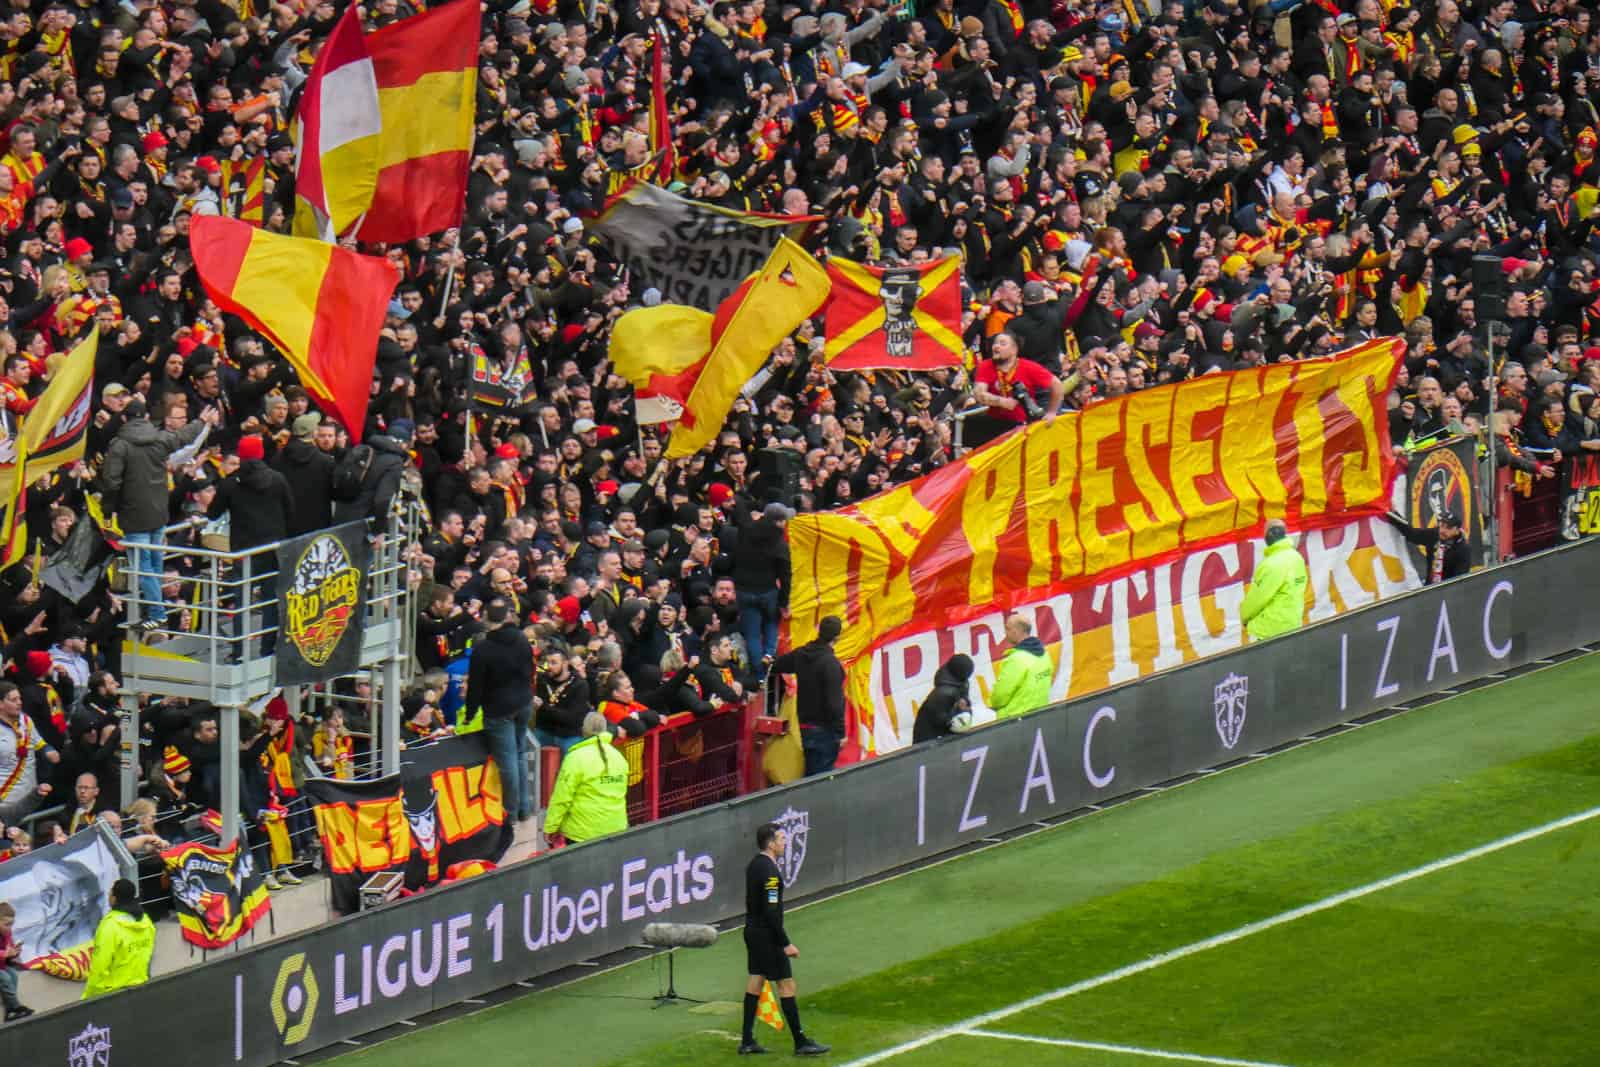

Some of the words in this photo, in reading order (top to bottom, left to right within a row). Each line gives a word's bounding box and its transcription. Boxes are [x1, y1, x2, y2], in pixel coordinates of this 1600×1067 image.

[961, 338, 1397, 606] PRESENTS
[1091, 516, 1424, 685] TIGRS
[1340, 580, 1514, 711] IZAC
[917, 705, 1117, 846] IZAC
[335, 912, 472, 1015] LIGUE
[486, 903, 504, 962] 1
[524, 882, 614, 952] Uber
[621, 849, 714, 921] Eats
